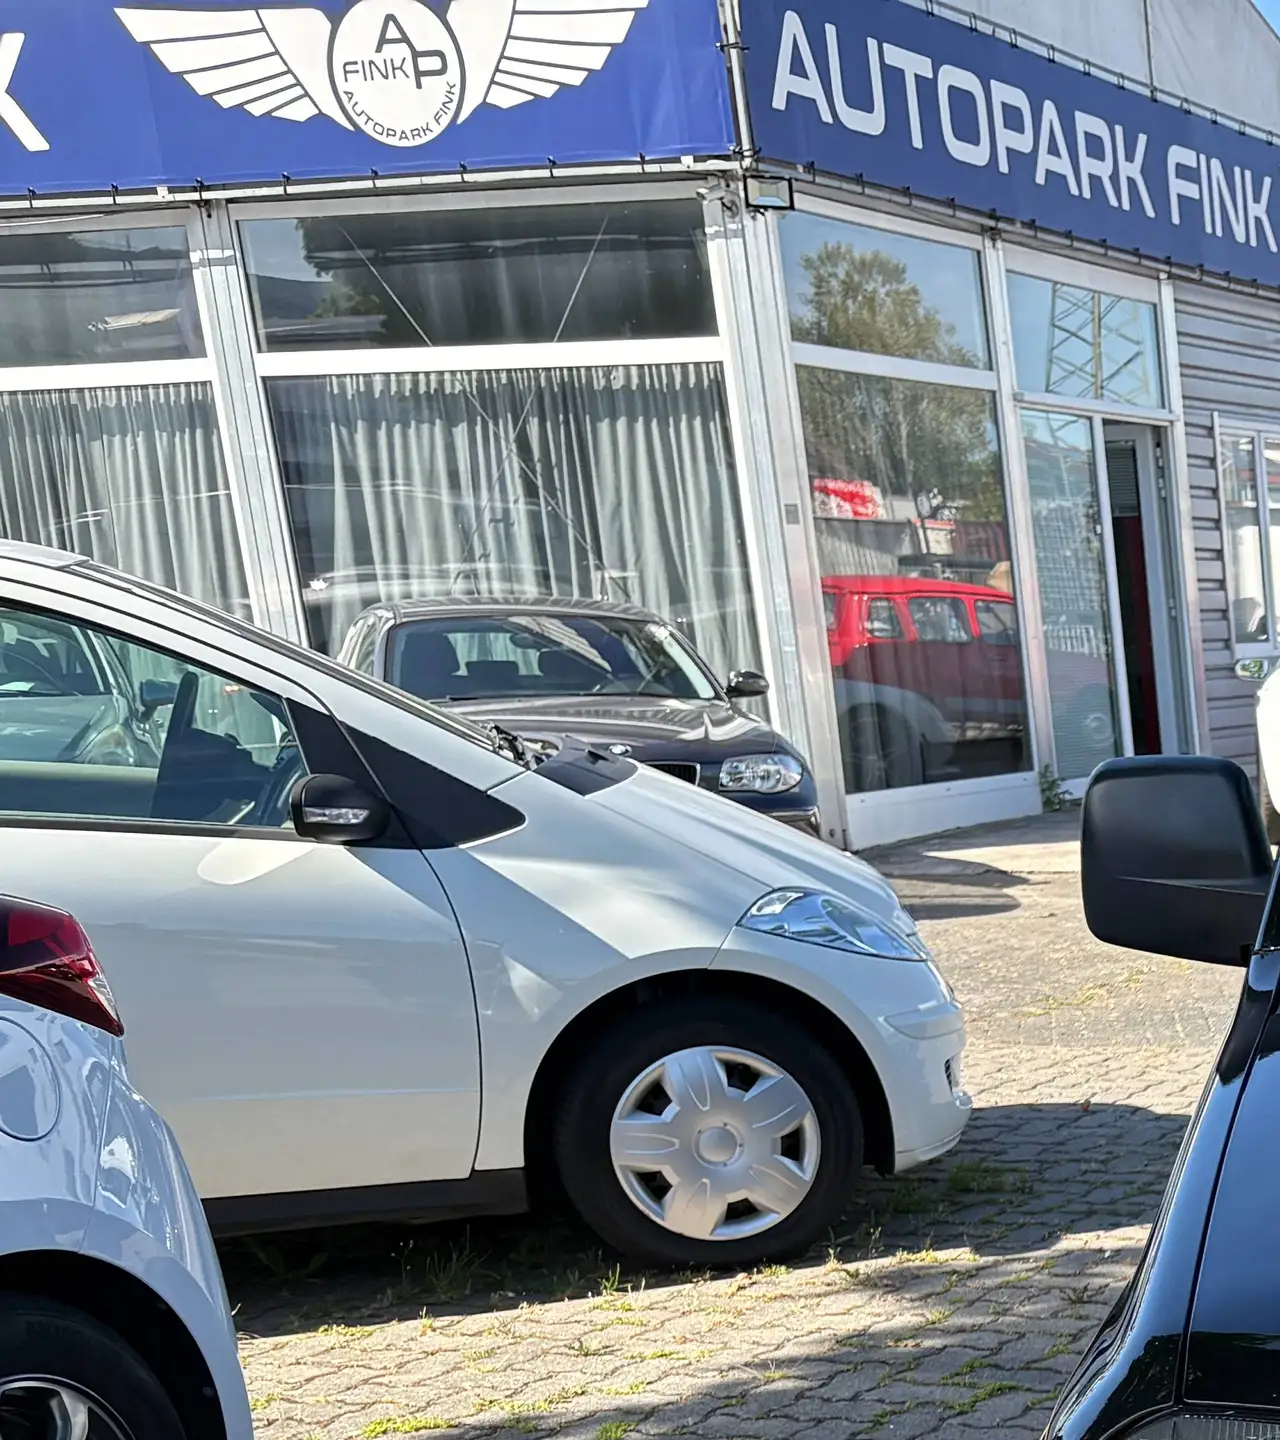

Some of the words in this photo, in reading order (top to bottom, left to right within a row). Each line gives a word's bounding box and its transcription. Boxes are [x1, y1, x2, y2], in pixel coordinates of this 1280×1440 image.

[342, 57, 411, 83] FINK
[342, 90, 434, 142] AUTOPARK
[433, 81, 457, 126] FINK
[771, 9, 1157, 219] AUTOPARK
[1166, 143, 1279, 254] FINK
